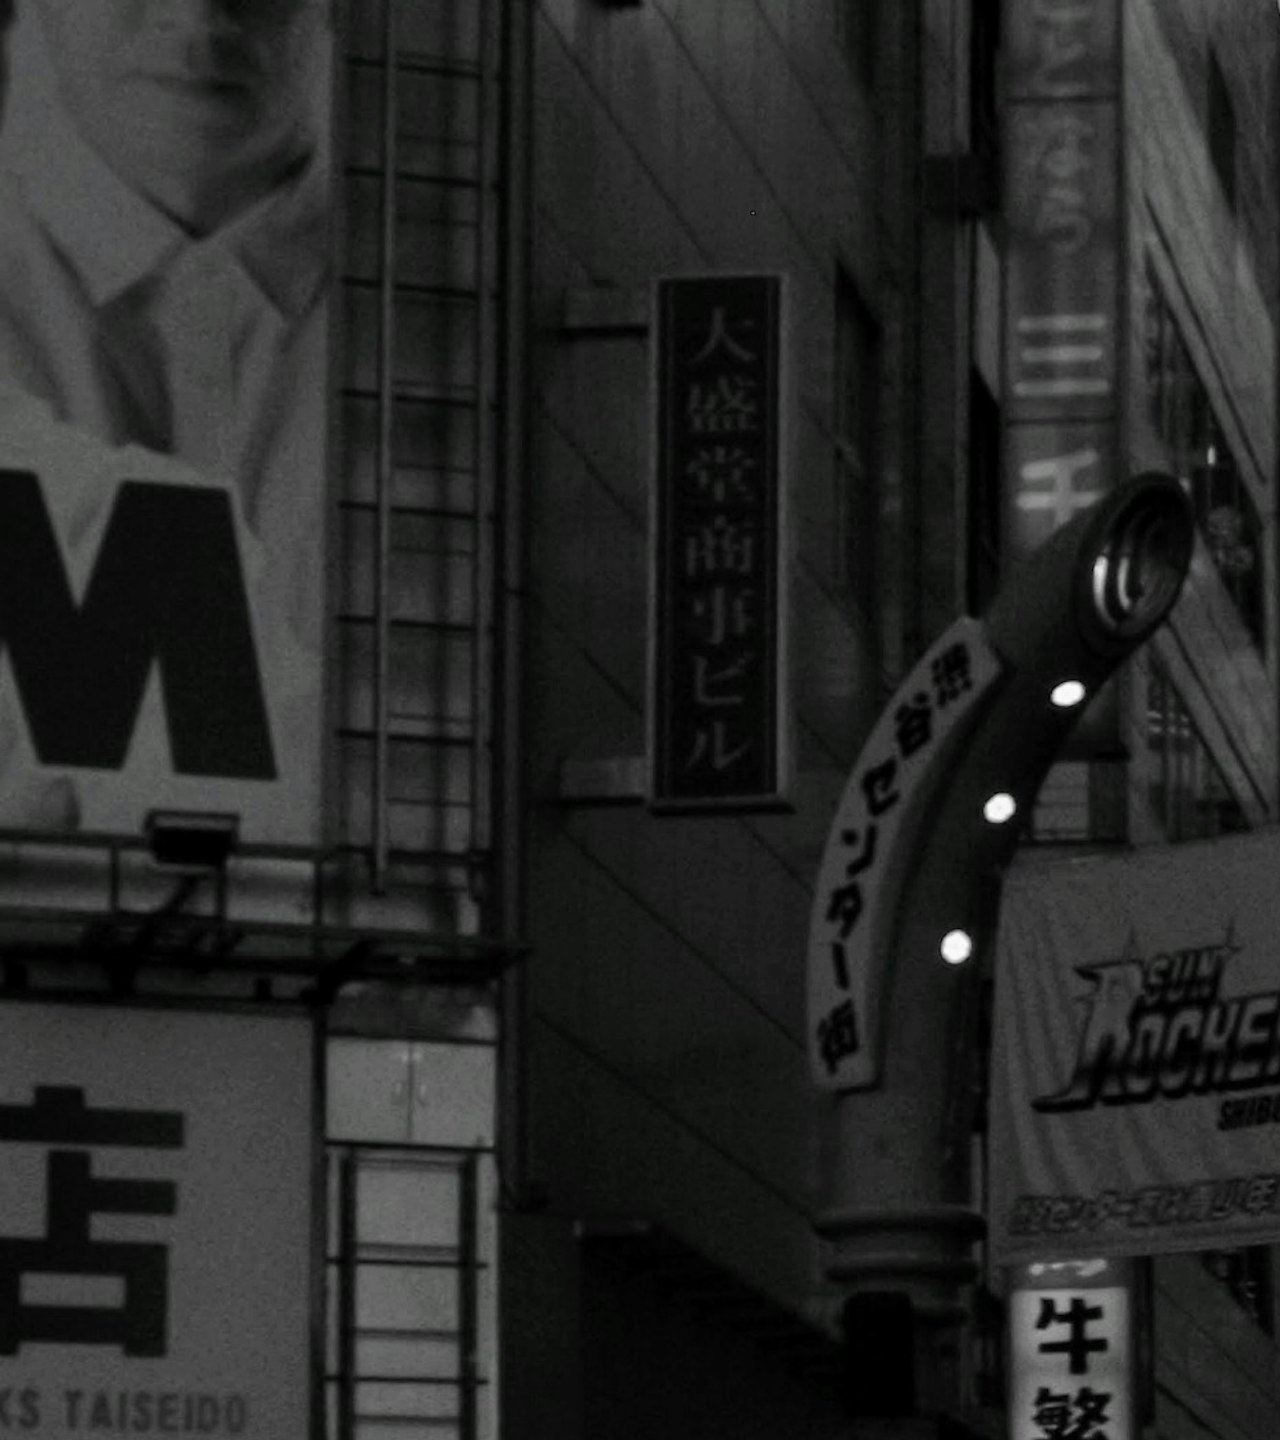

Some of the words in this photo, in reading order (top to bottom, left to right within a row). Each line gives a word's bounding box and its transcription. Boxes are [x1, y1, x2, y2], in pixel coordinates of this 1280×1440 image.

[815, 640, 972, 1075] 渋谷センター街
[1142, 943, 1242, 1003] SUN
[65, 1389, 248, 1434] TAISEIDO
